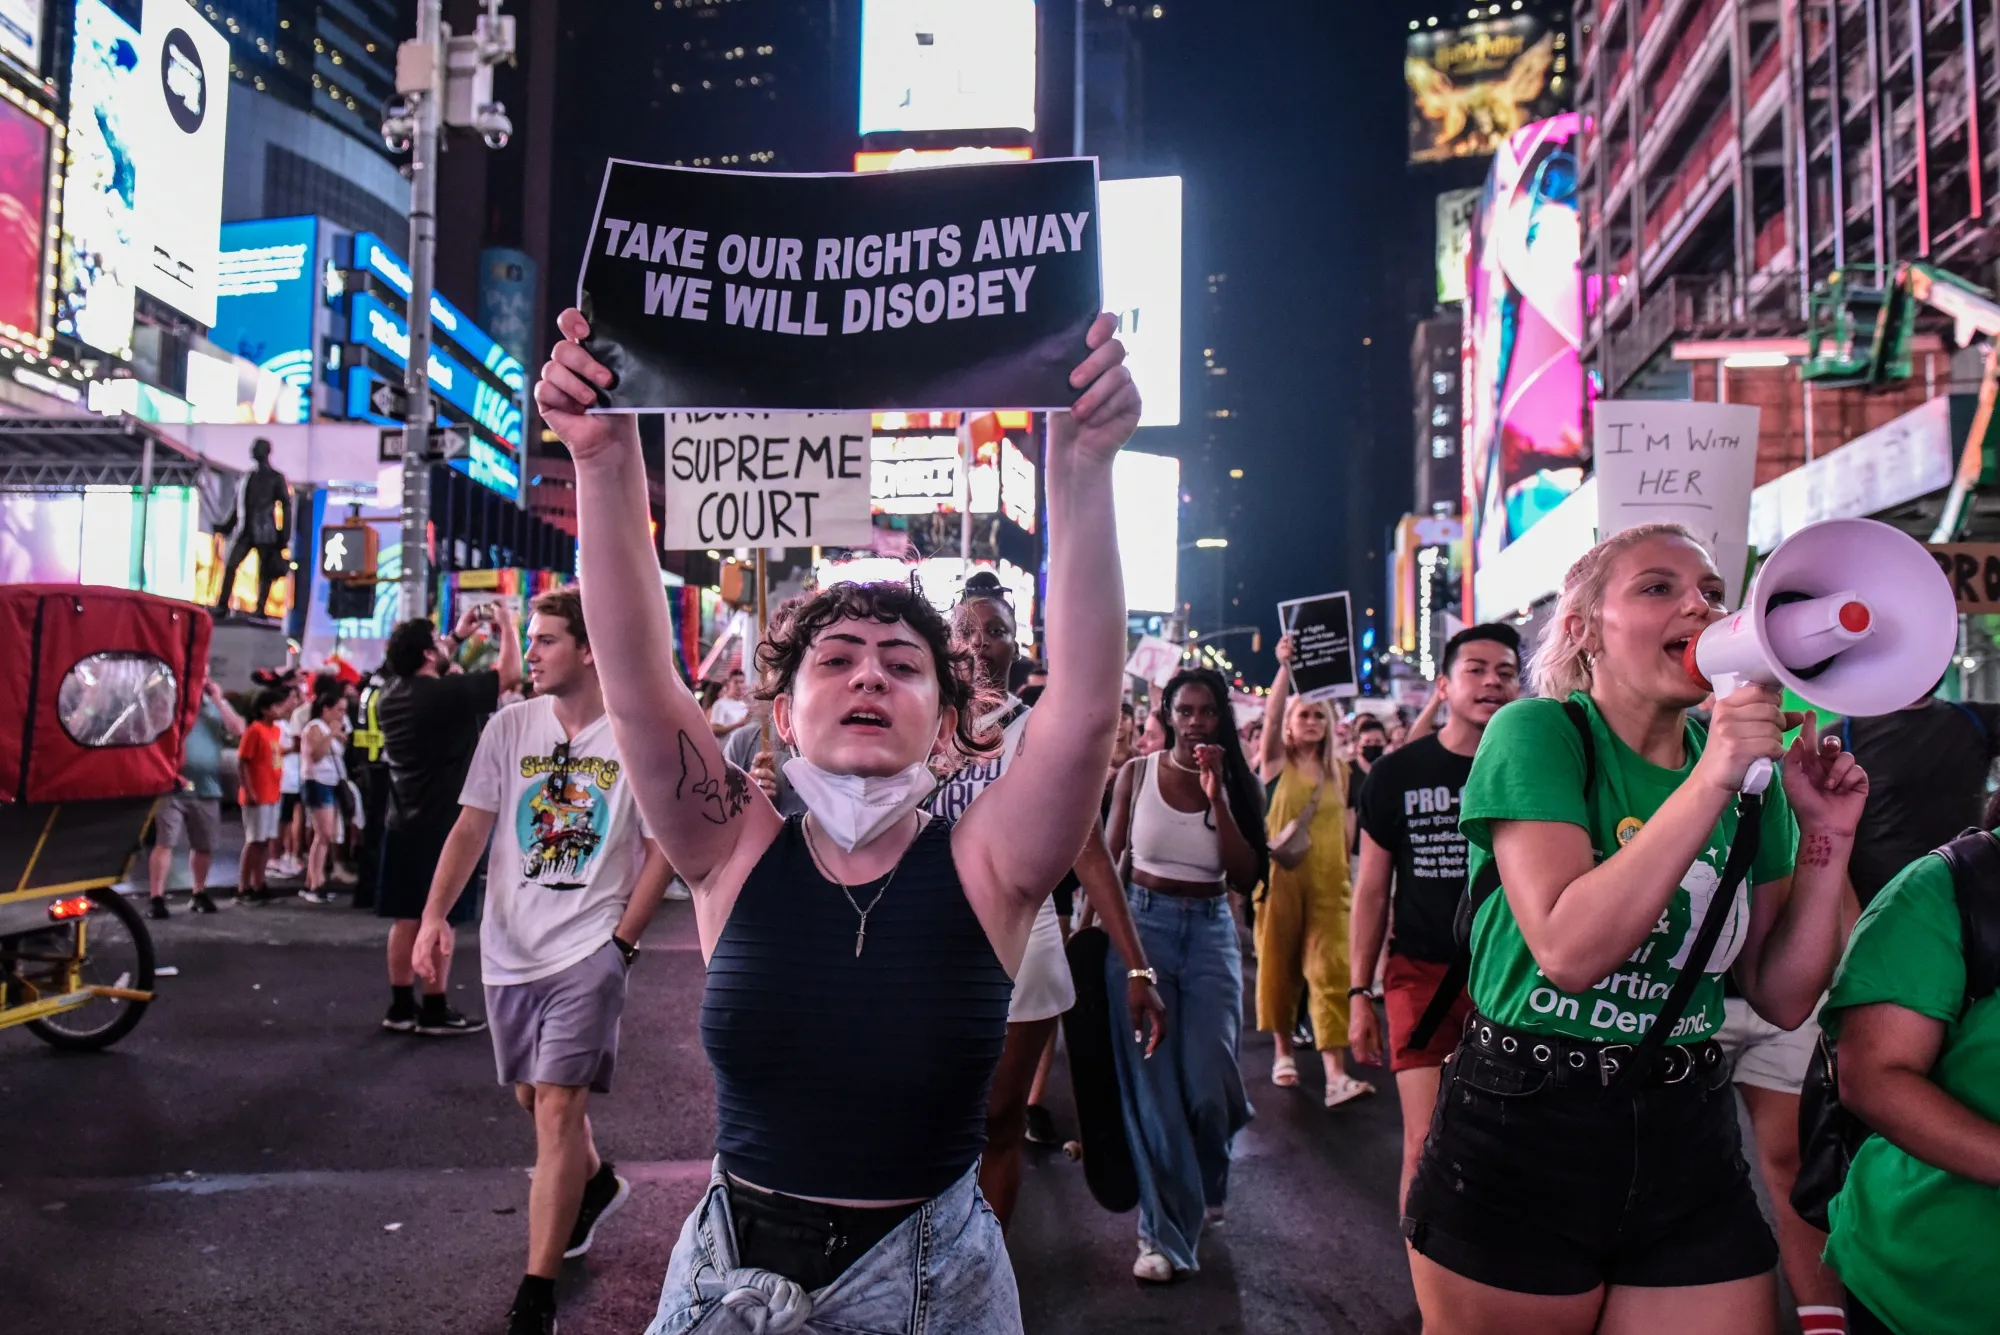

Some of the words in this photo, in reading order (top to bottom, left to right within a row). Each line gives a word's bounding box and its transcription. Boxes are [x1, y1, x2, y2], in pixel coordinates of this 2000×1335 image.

[604, 218, 708, 269] TAKE
[718, 234, 803, 280] OUR
[814, 224, 961, 280] RIGHTS
[972, 212, 1089, 262] AWAY
[645, 271, 712, 321] WE
[726, 283, 828, 335] WILL
[842, 265, 1036, 334] DISOBEY
[1605, 423, 1670, 454] I'M
[672, 435, 863, 483] SUPREME
[1638, 468, 1702, 495] HER
[698, 490, 819, 543] COURT
[520, 755, 619, 790] SWGERS
[956, 757, 1001, 782] OOD
[1404, 786, 1465, 815] PRO-
[1409, 833, 1427, 843] The
[1447, 845, 1466, 854] are
[1438, 855, 1464, 866] their
[1440, 867, 1466, 878] their
[1529, 988, 1579, 1020] On
